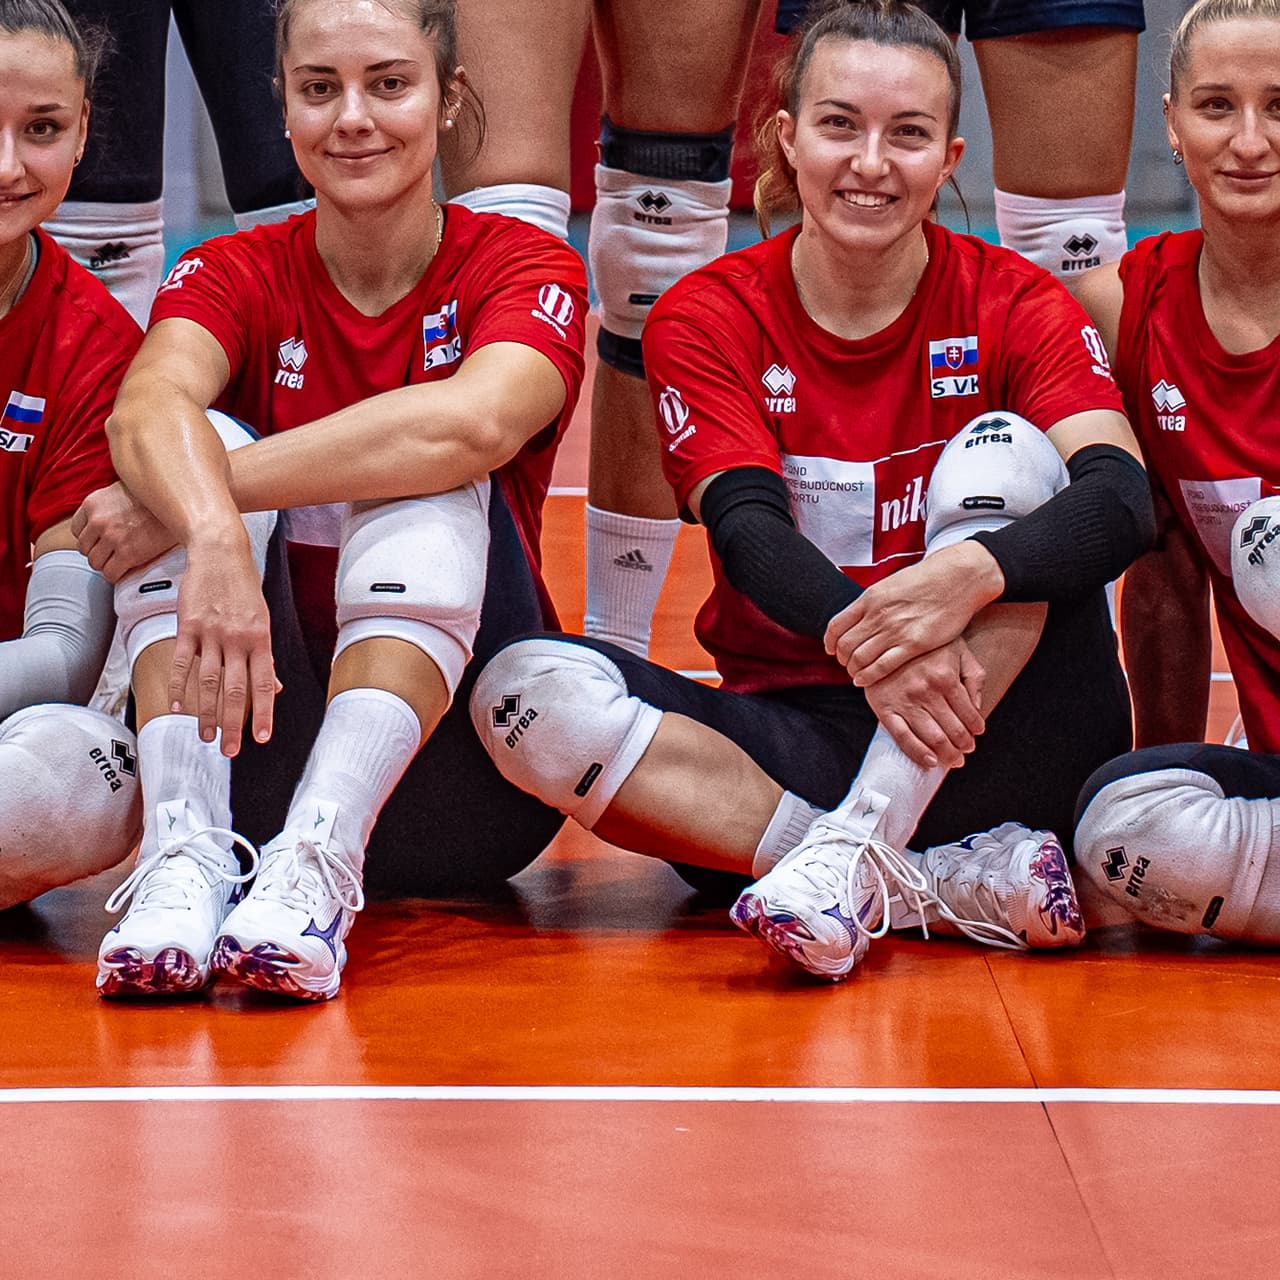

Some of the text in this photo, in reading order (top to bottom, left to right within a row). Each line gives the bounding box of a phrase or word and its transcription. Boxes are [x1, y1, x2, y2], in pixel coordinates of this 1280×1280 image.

[273, 369, 305, 390] rrea
[964, 431, 1014, 450] errea
[880, 475, 927, 533] nik
[504, 706, 538, 750] errea
[88, 747, 125, 794] errea
